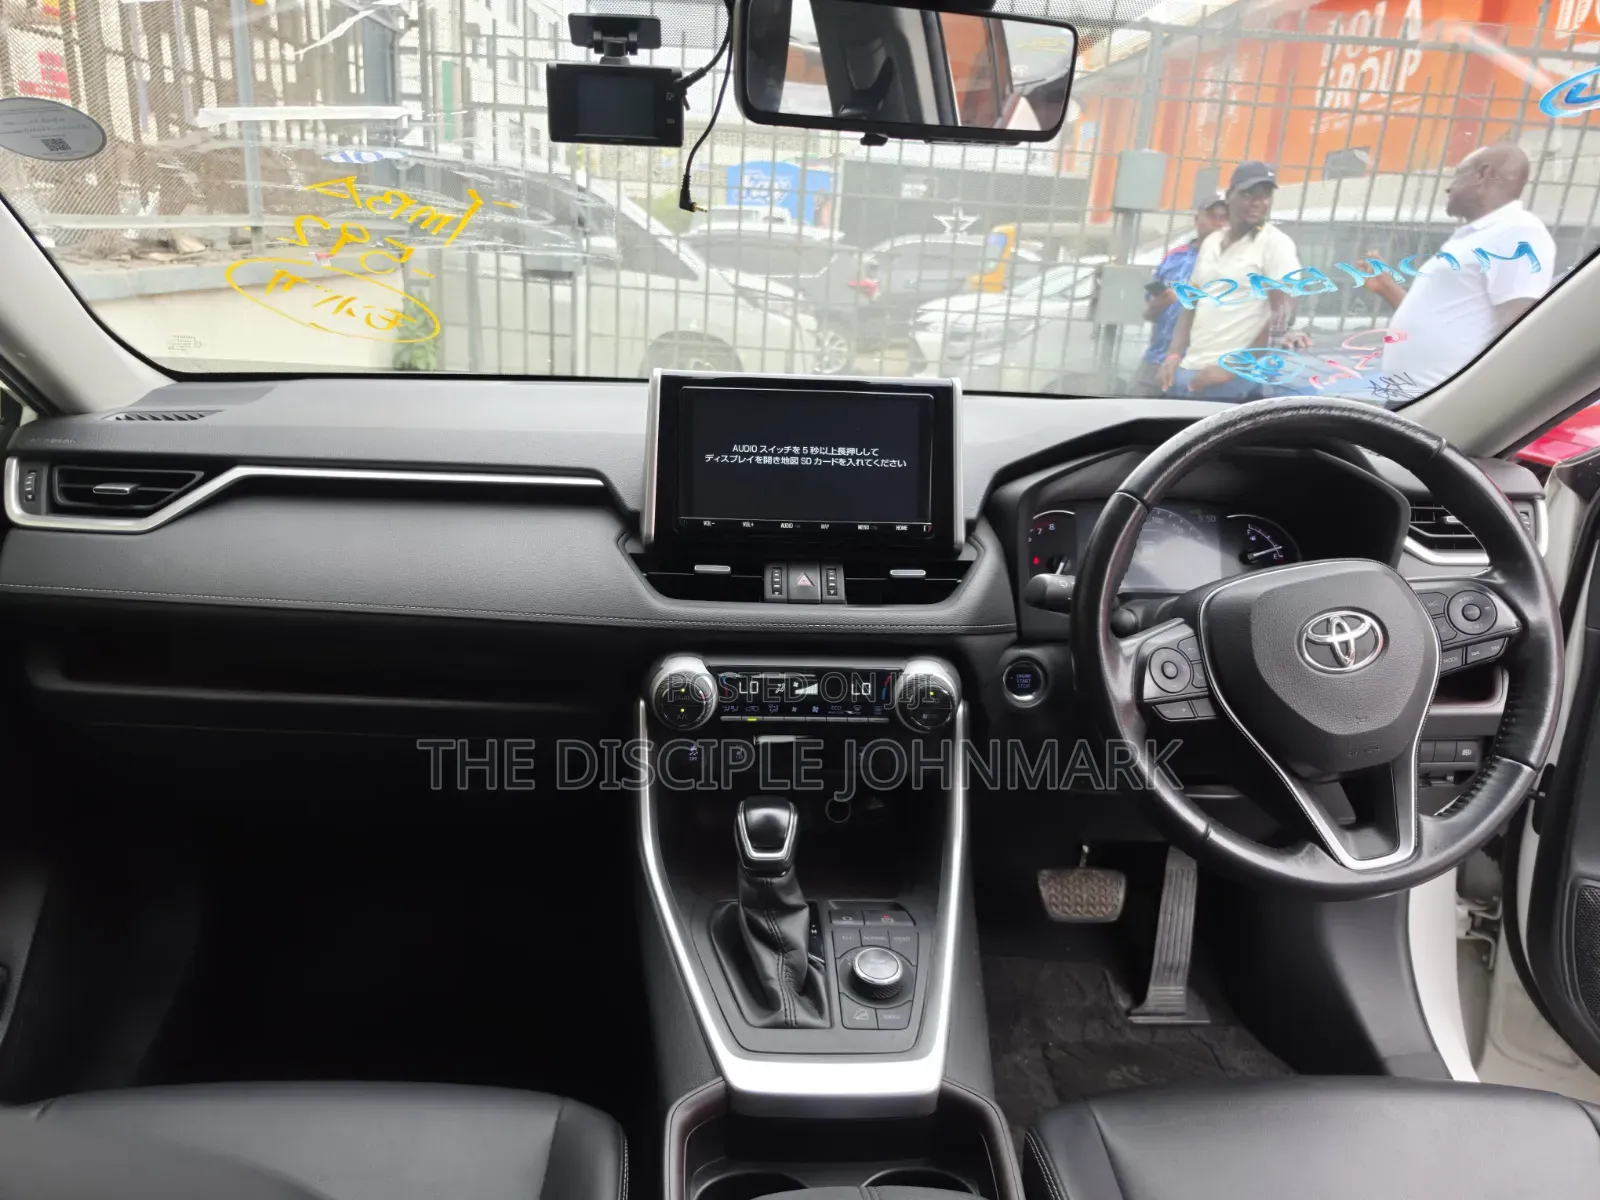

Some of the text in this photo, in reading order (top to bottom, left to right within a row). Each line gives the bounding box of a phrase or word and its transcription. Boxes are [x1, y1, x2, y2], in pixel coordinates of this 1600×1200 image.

[732, 444, 880, 456] AUDIO スイッチを 5 秒以上長押しして
[704, 454, 907, 468] ディスプレイを開き地図 SD カードを入れてください
[1037, 527, 1043, 535] 7
[1048, 523, 1055, 531] 8
